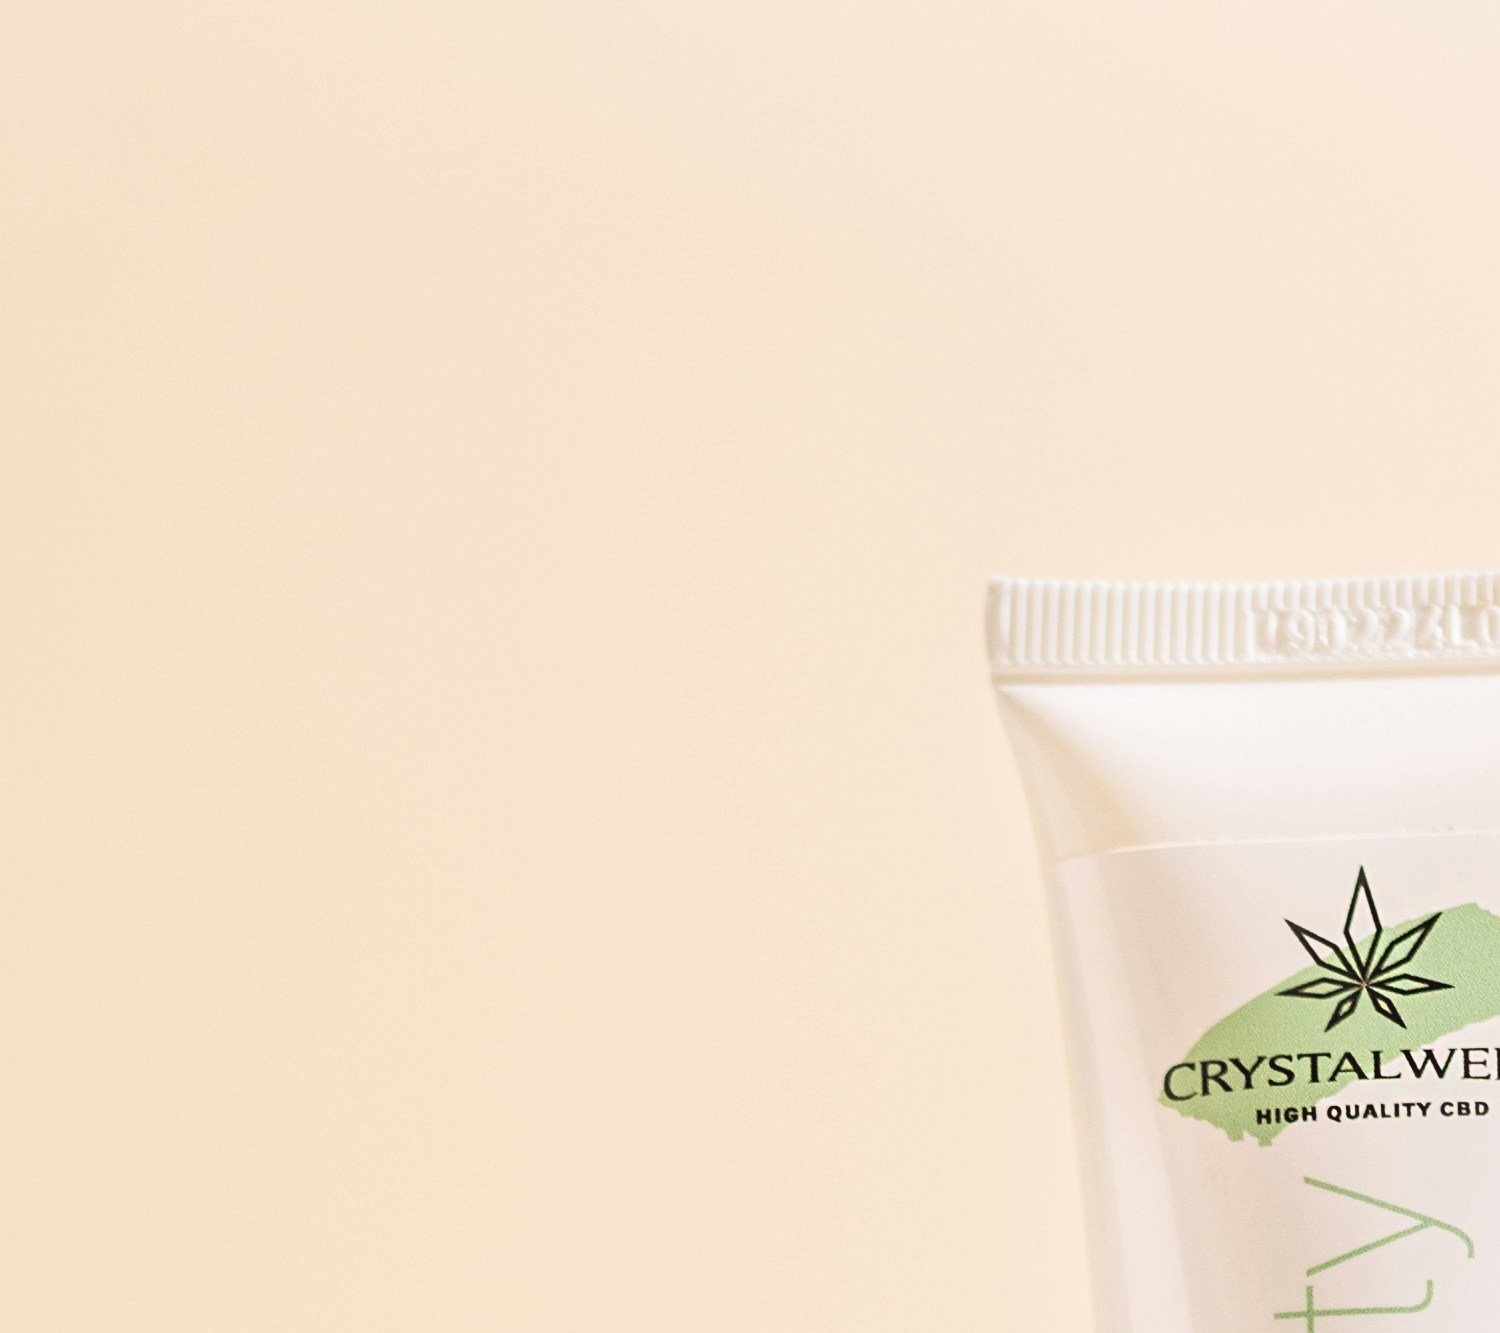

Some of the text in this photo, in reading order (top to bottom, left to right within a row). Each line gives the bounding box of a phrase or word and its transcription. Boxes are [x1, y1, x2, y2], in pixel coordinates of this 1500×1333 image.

[1255, 1100, 1490, 1125] HIGH QUALITY CBD
